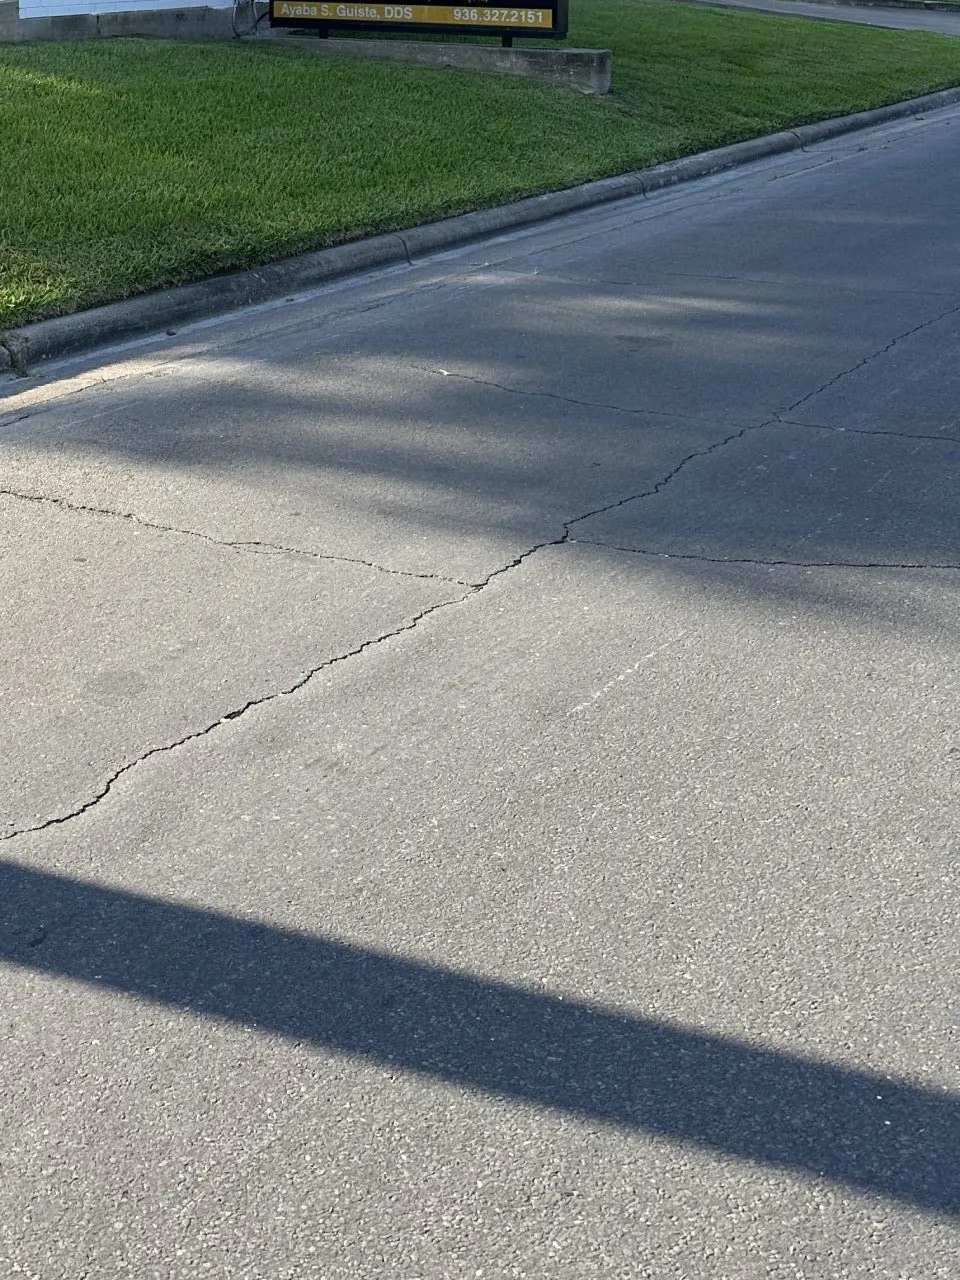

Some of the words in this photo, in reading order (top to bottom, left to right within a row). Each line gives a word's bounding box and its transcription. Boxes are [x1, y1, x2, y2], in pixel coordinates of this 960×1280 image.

[280, 3, 317, 17] Ayaba
[320, 4, 333, 17] S.
[336, 4, 380, 19] Guiste,
[384, 6, 413, 19] DDS
[453, 8, 543, 24] 936.327.2151
